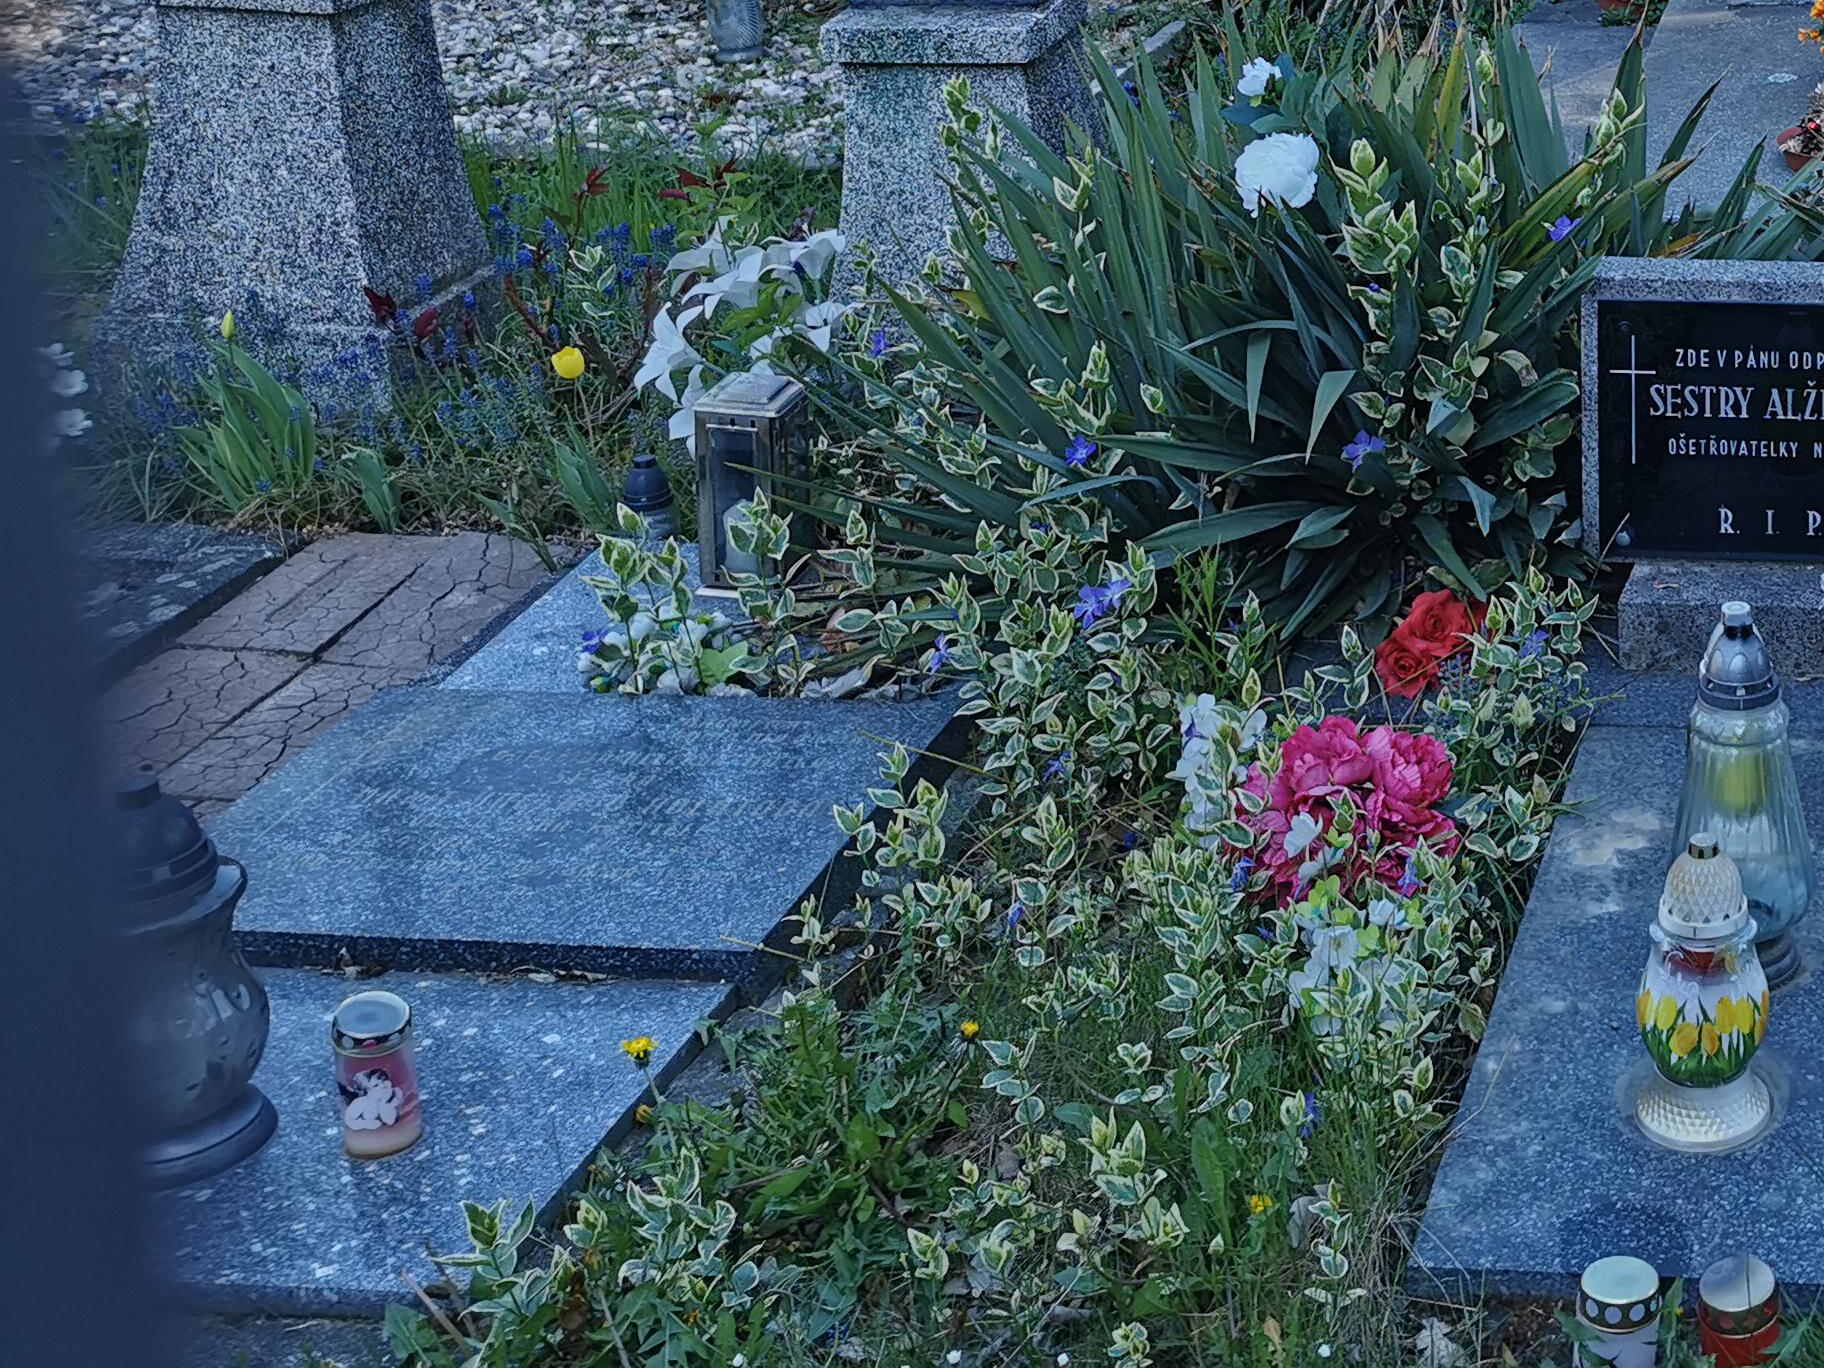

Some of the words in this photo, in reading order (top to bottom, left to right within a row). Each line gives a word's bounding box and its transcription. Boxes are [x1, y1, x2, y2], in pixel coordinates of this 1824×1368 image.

[1674, 348, 1710, 368] ZDE
[1717, 349, 1727, 367] V
[1734, 344, 1780, 369] PÁNU
[1649, 383, 1754, 419] SESTRY
[1668, 433, 1799, 458] OŠETŘOVATELKY
